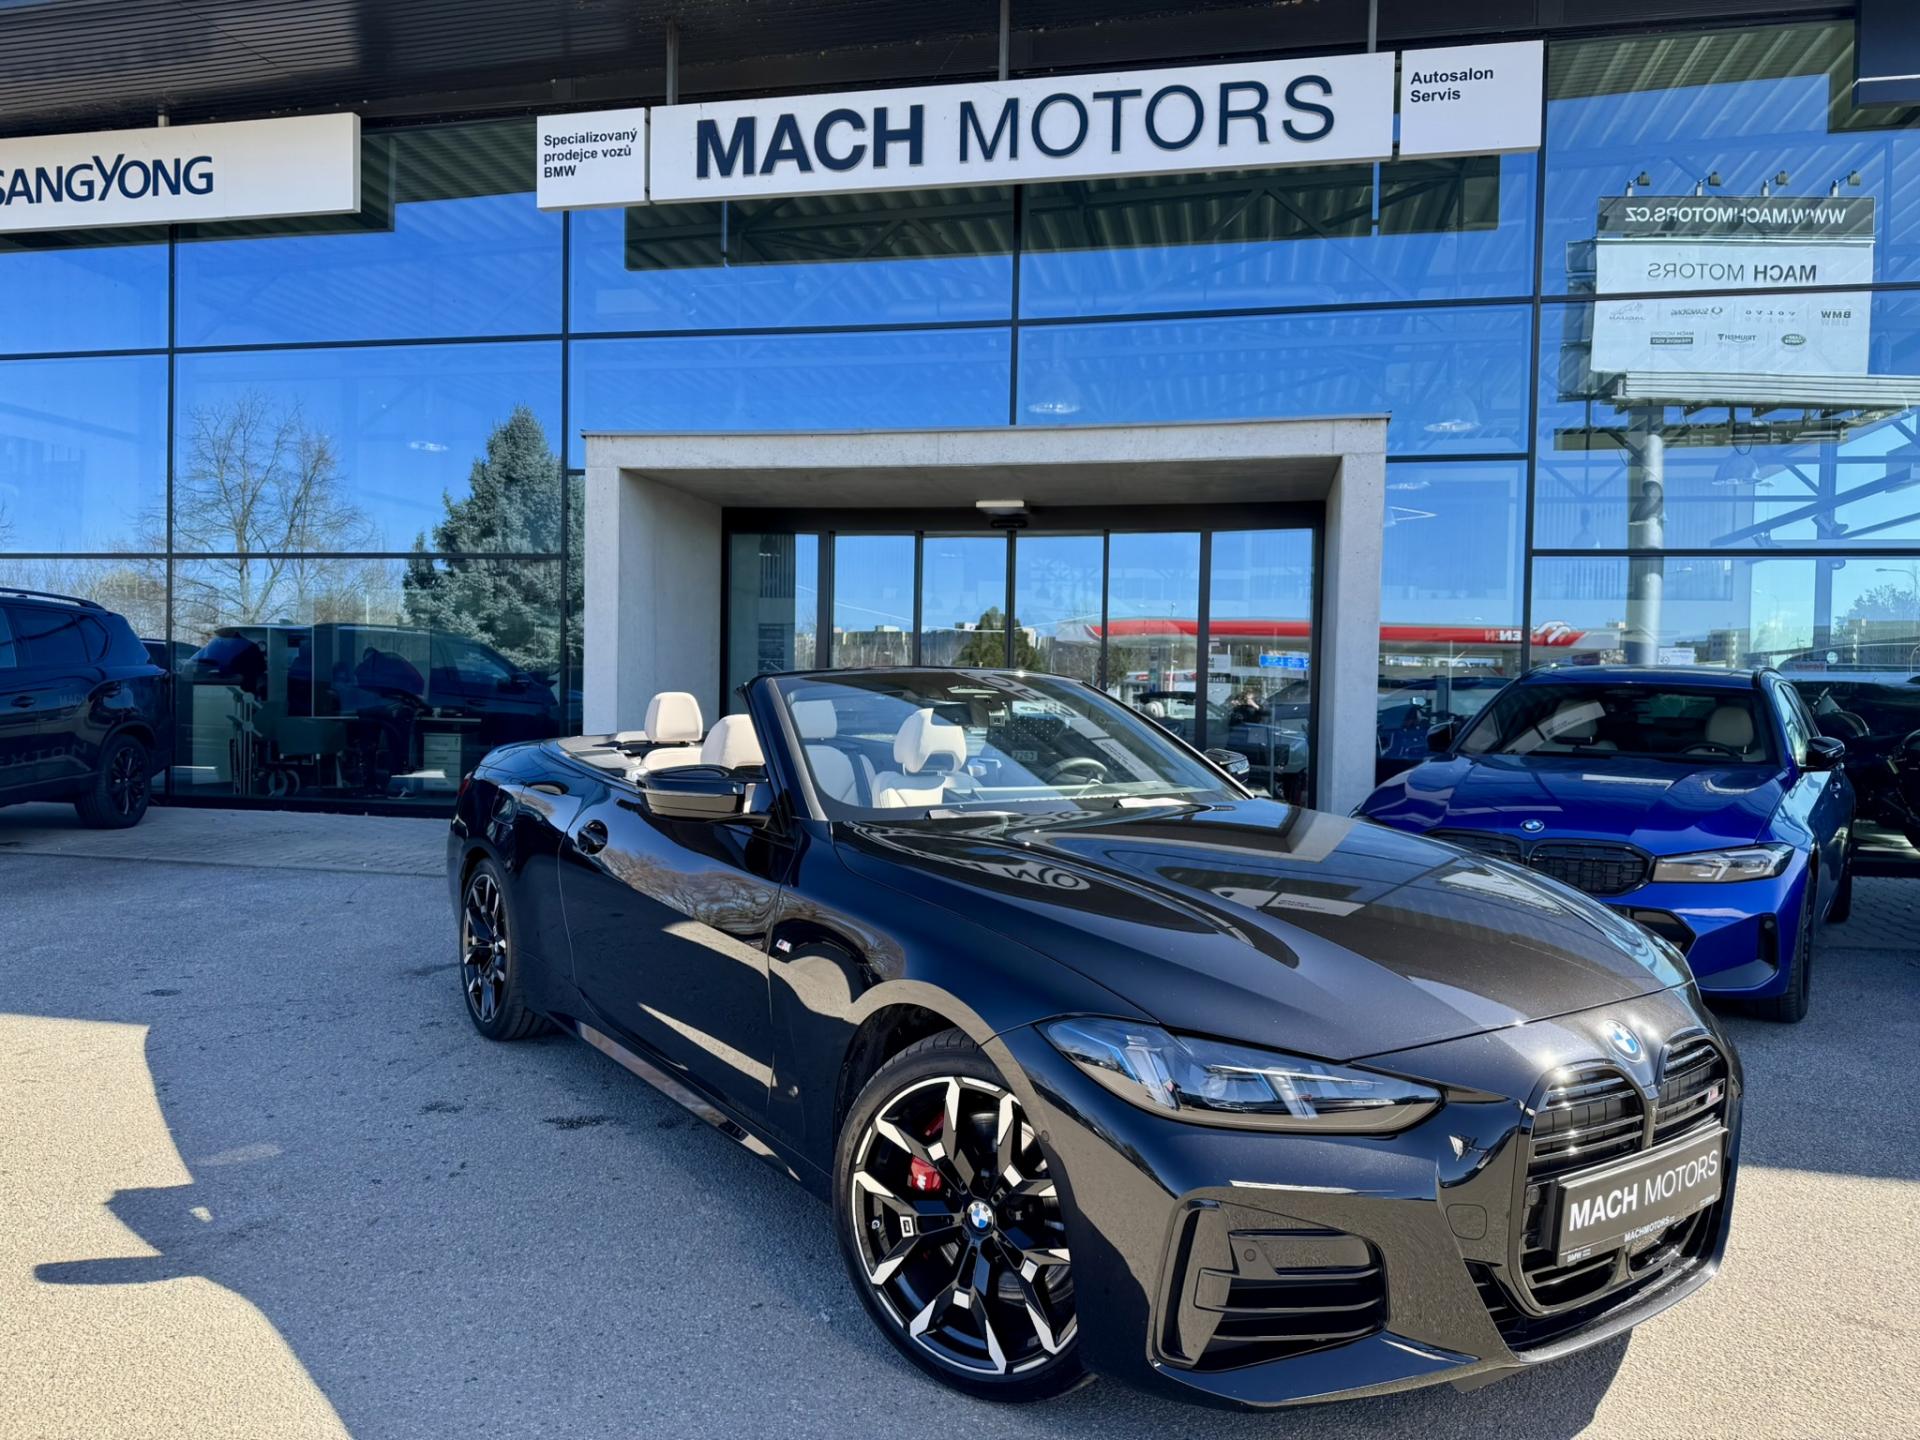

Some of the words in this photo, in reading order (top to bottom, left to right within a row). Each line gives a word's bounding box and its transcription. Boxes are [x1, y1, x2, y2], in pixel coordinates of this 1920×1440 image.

[1410, 67, 1494, 85] Autosalon
[1410, 87, 1461, 103] Servis
[544, 127, 638, 148] Specializovaný
[696, 104, 925, 179] MACH
[959, 75, 1335, 162] MOTORS
[544, 149, 598, 165] prodejce
[601, 144, 632, 159] vozů
[544, 164, 577, 179] BMW
[1569, 1183, 1638, 1231] MACH
[1644, 1149, 1718, 1206] MOTORS
